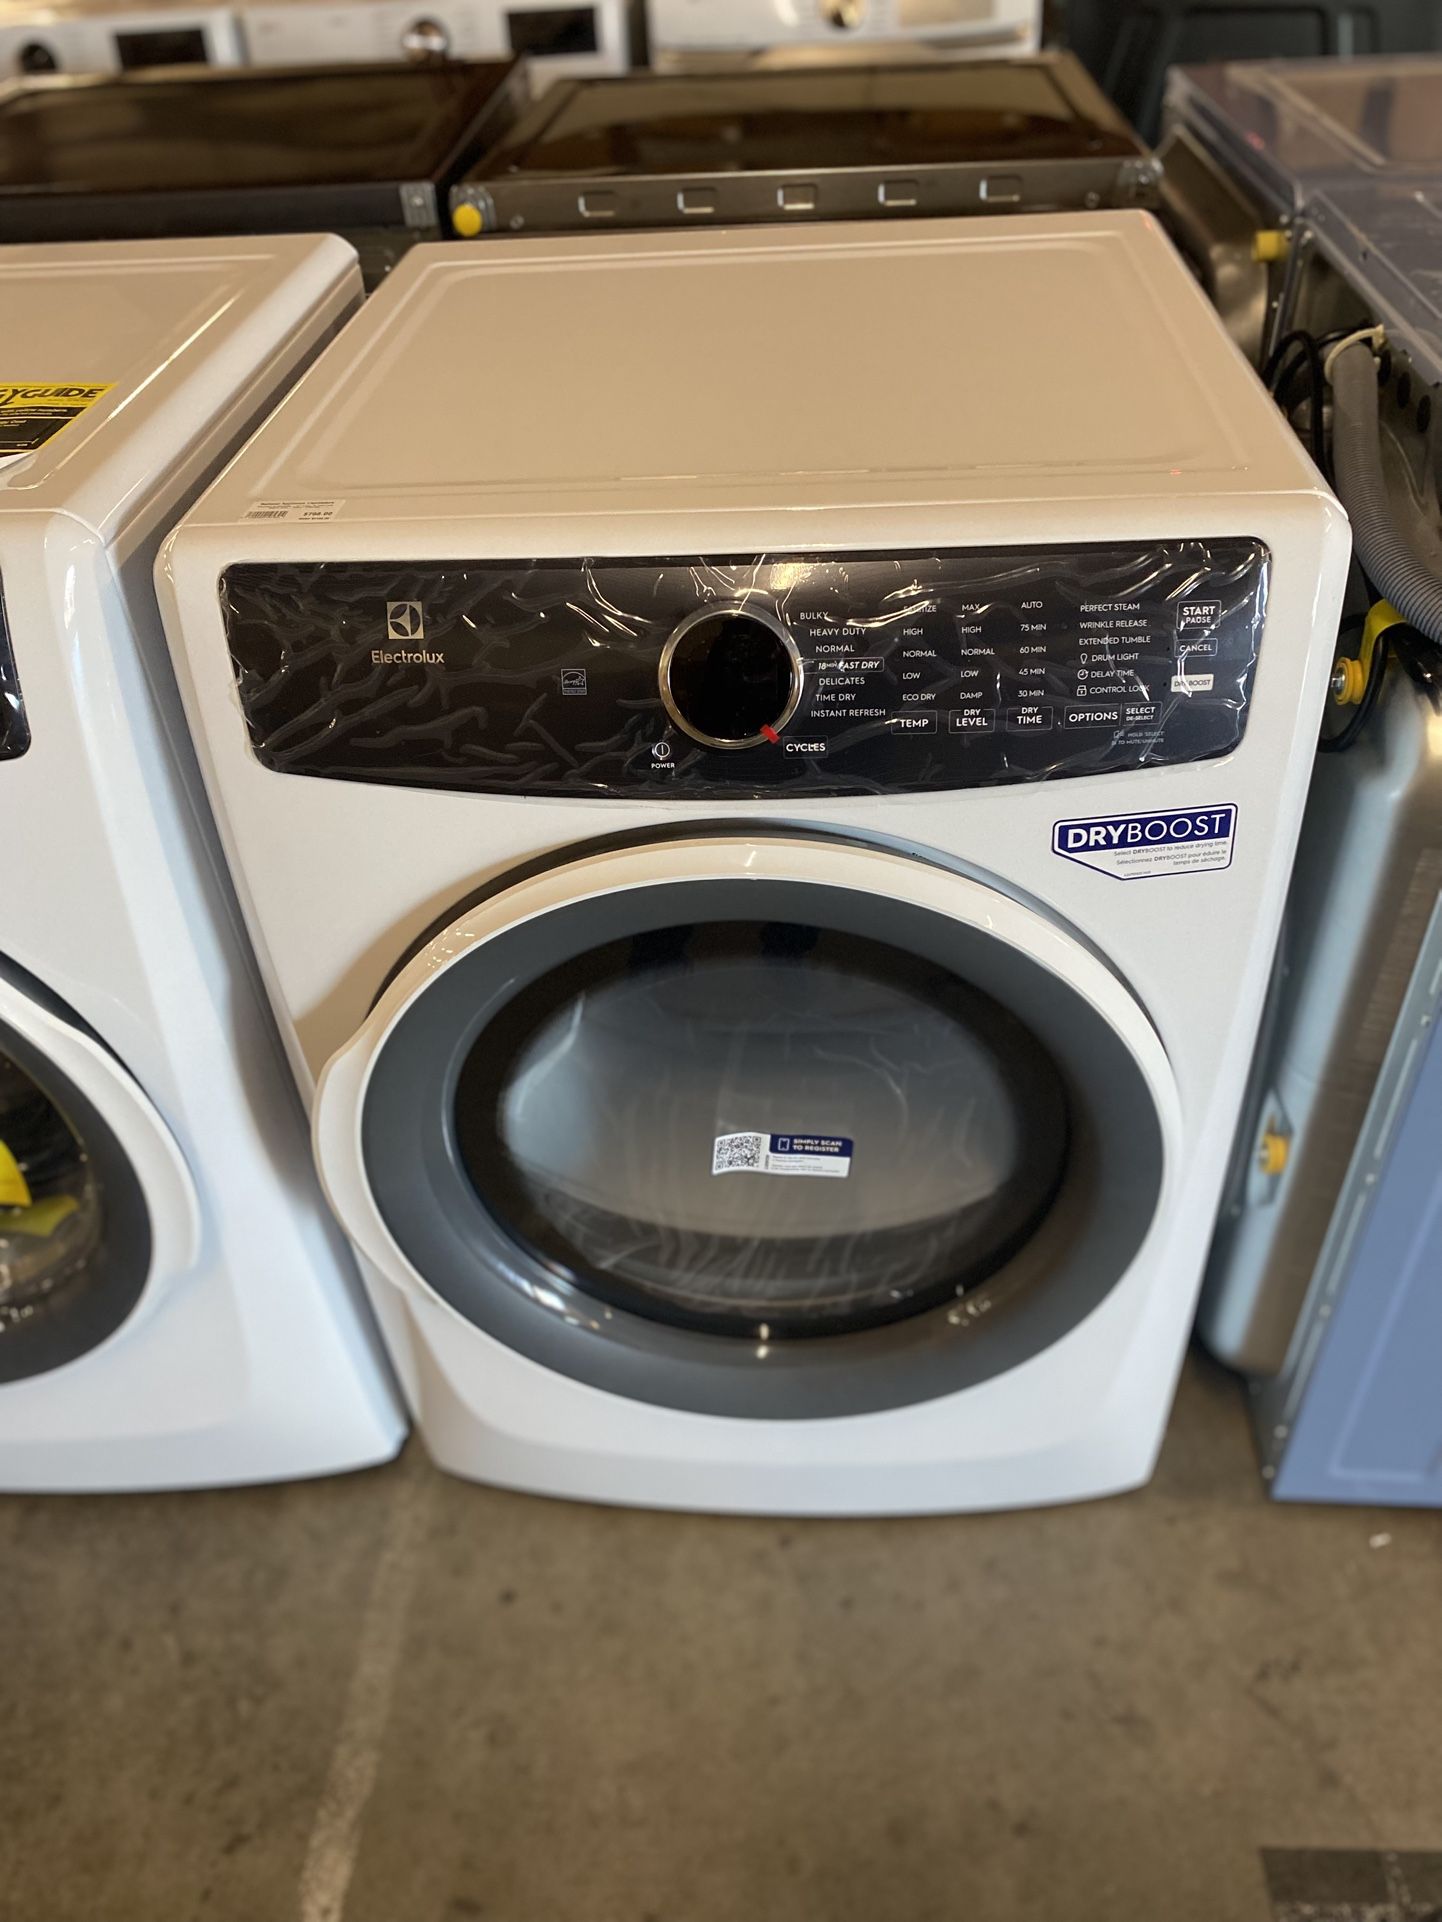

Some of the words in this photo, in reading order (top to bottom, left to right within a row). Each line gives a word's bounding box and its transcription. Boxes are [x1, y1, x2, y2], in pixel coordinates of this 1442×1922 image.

[1020, 601, 1043, 609] AUTO
[1080, 604, 1112, 612] PERFECT
[1114, 603, 1140, 611] STEAM
[800, 611, 829, 620] BULKY
[1183, 606, 1216, 616] START
[1079, 621, 1114, 629] WRINKLE
[1115, 620, 1148, 628] RELEASE
[1185, 616, 1212, 624] PAUSE
[810, 628, 840, 637] HEAVY
[842, 628, 867, 636] DUTY
[903, 628, 924, 636] HIGH
[961, 626, 982, 634] HIGH
[1079, 637, 1120, 646] EXTENDED
[1121, 636, 1151, 644] TUMBLE
[816, 645, 855, 653] NORMAL
[961, 648, 995, 656] NORMAL
[1179, 644, 1213, 652] CANCEL
[371, 650, 445, 664] Electrolux
[902, 650, 937, 658] NORMAL
[1091, 653, 1116, 662] DRUM
[1117, 653, 1140, 661] LIGHT
[838, 660, 860, 670] FAST
[861, 661, 881, 669] DRY
[902, 672, 921, 680] LOW
[960, 670, 979, 678] LOW
[1018, 668, 1029, 676] 45
[1090, 670, 1115, 678] DELAY
[818, 677, 866, 686] DELICATES
[1017, 690, 1028, 698] 30
[1089, 685, 1127, 694] CONTROL
[815, 694, 836, 702] TIME
[838, 693, 856, 701] DRY
[960, 692, 983, 700] DAMP
[810, 709, 847, 718] INSTANT
[848, 708, 886, 717] REFRESH
[1126, 706, 1156, 715] SELECT
[1017, 715, 1043, 724] TIME
[1068, 711, 1118, 723] OPTIONS
[900, 719, 929, 728] TEMP
[956, 717, 988, 727] LEVEL
[785, 742, 826, 753] CYCLES
[1067, 813, 1226, 849] DRYBOOST
[1132, 847, 1166, 855] DRYBOOST
[1153, 853, 1187, 862] DRYBOOST
[793, 1138, 820, 1146] SIMPLY
[804, 1145, 840, 1153] REGISTER
